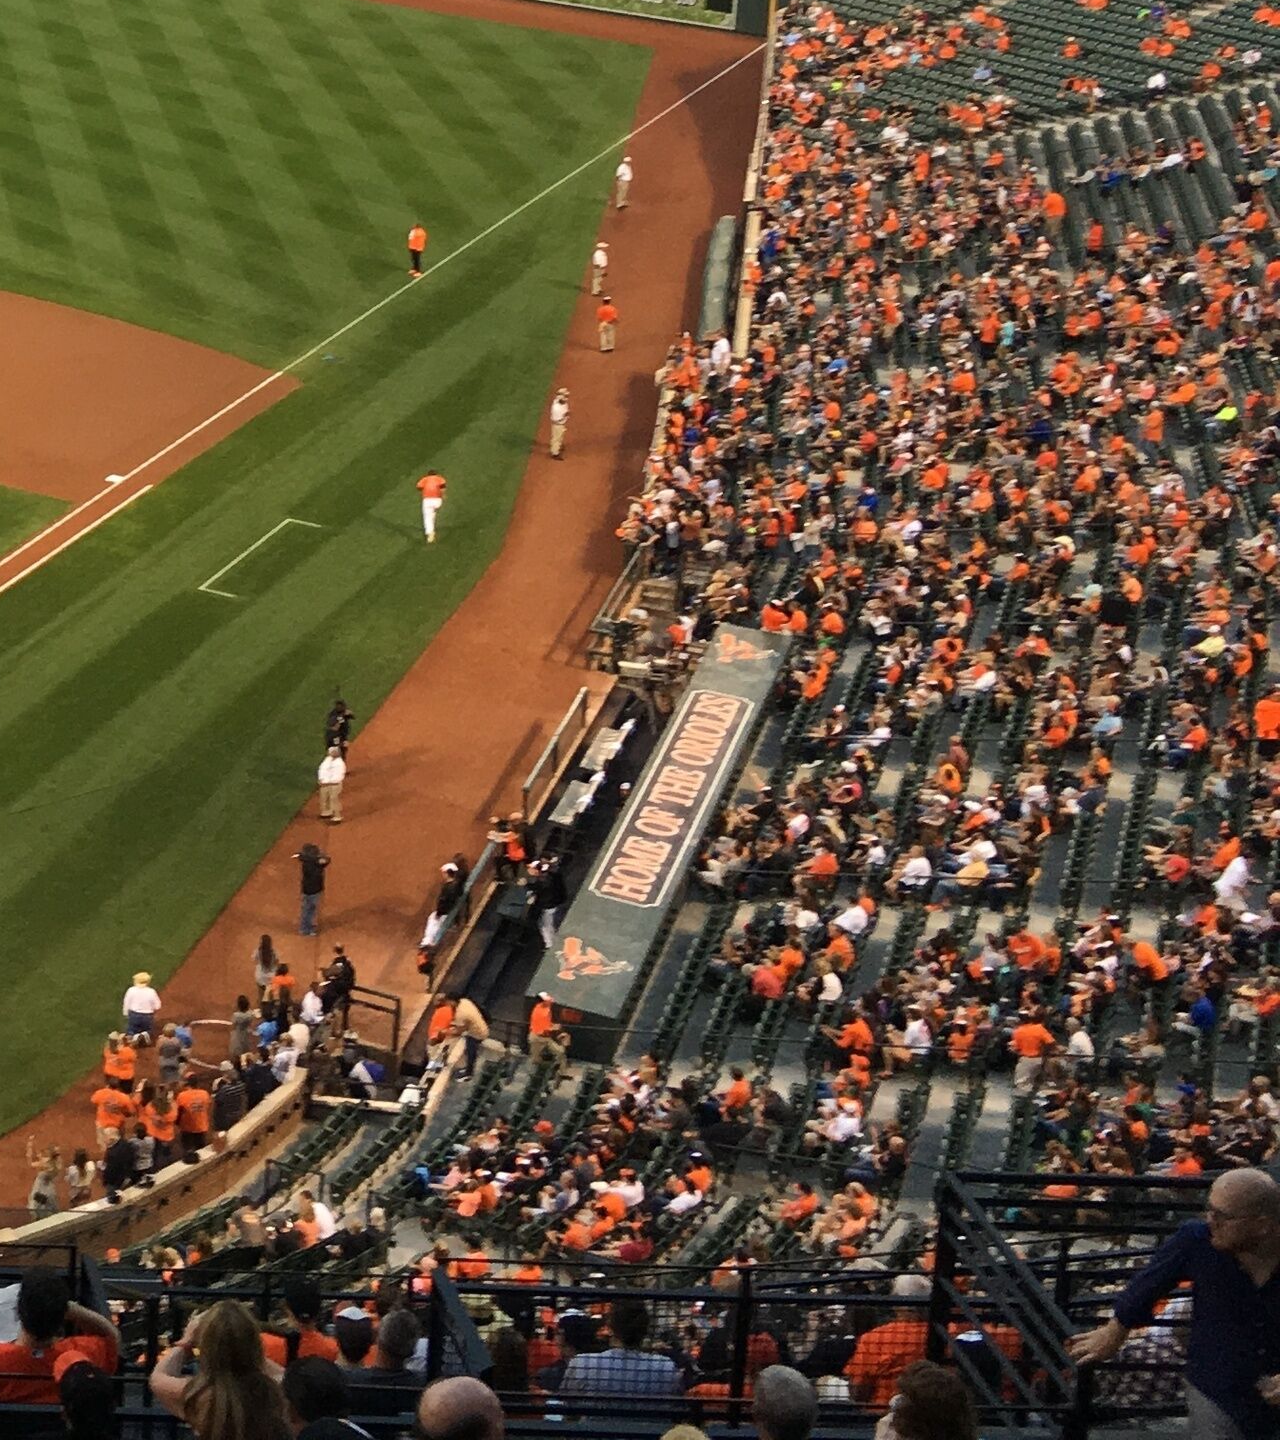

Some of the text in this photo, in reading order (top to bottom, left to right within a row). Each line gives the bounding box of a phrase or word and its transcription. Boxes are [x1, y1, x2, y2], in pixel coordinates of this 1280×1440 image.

[601, 693, 741, 903] HOME OF THE ORIOLES
